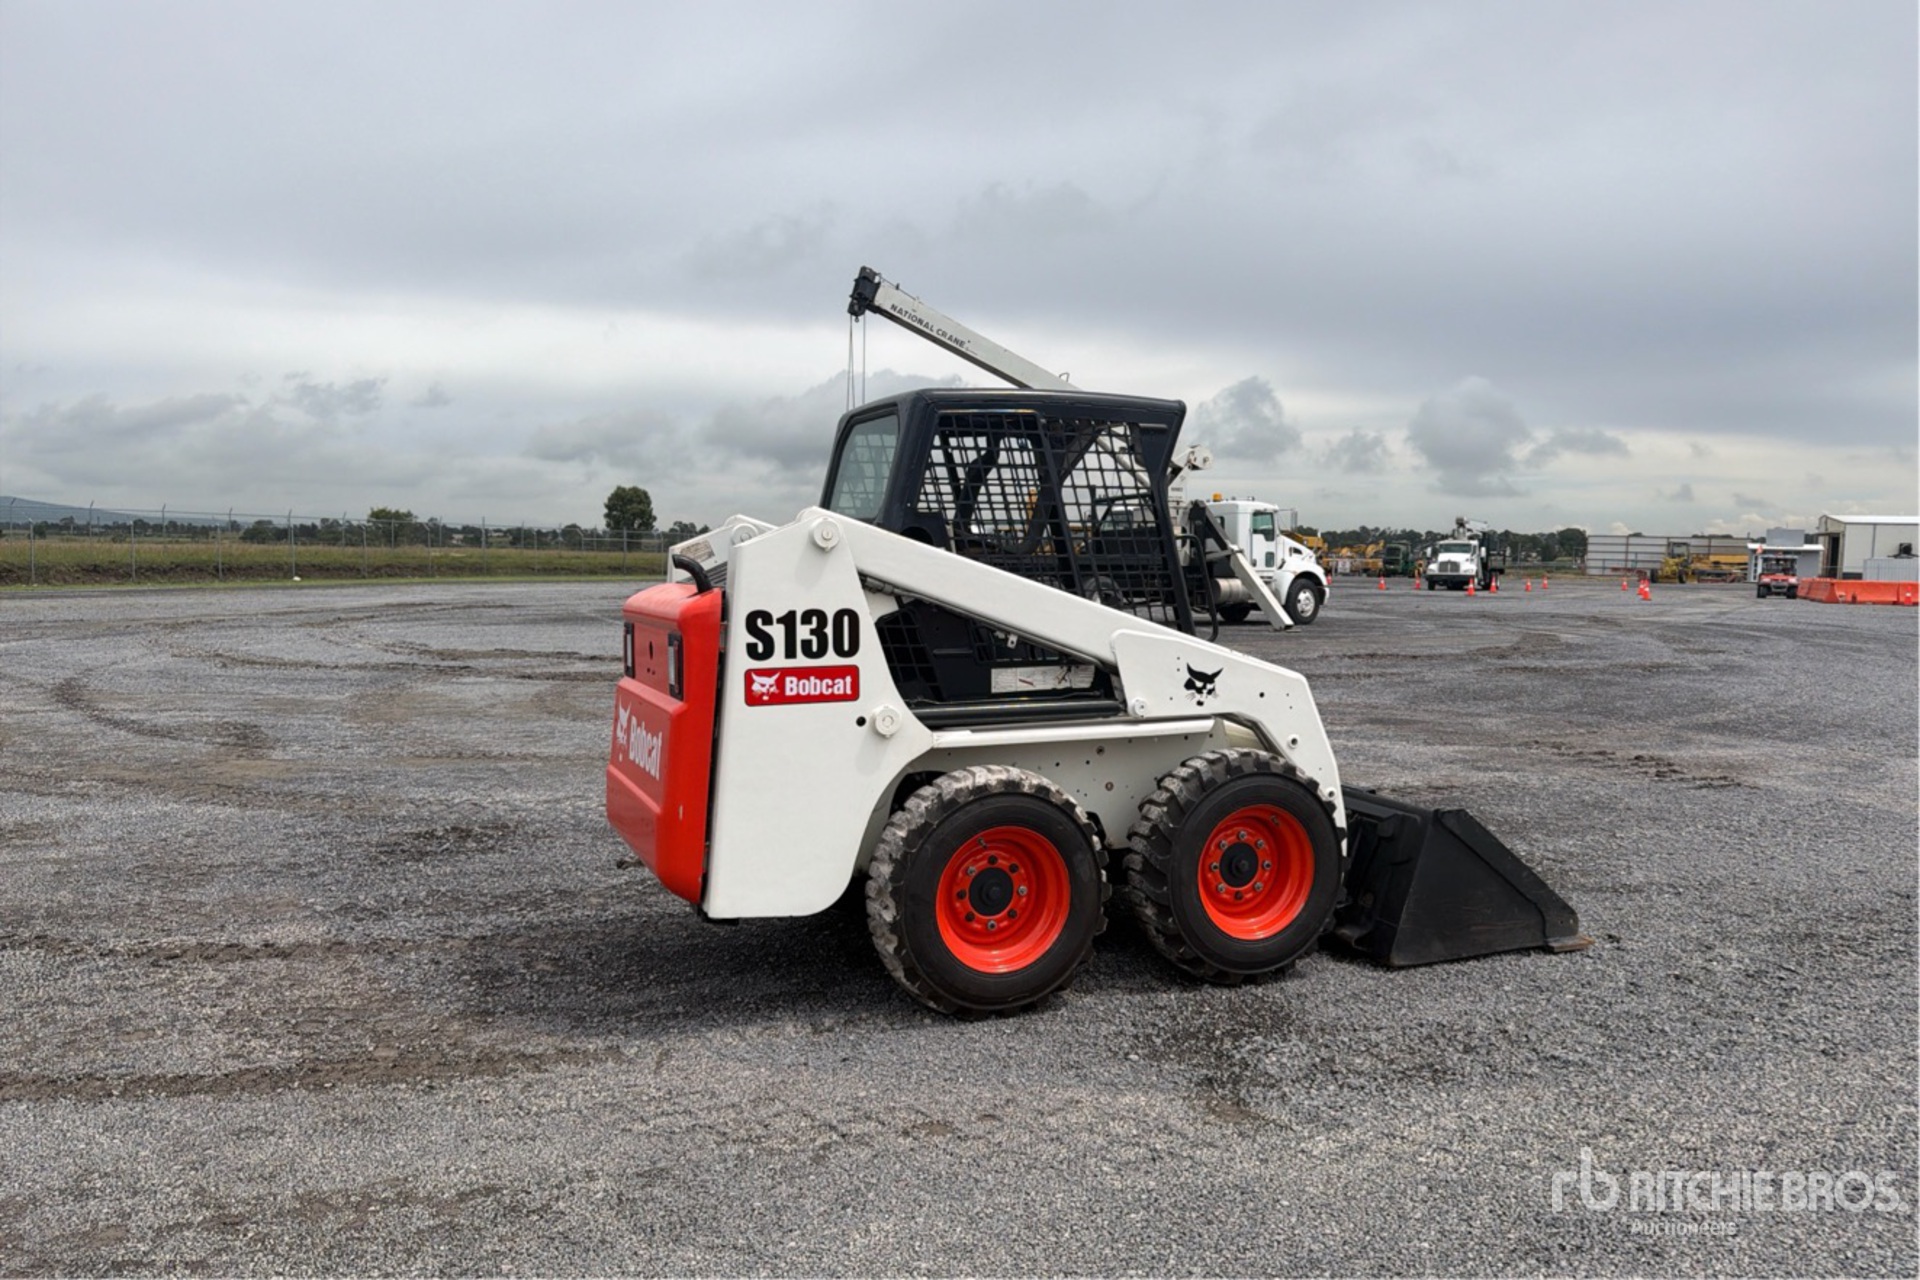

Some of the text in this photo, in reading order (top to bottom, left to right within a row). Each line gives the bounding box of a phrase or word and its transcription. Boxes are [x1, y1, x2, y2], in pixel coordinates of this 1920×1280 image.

[890, 303, 966, 349] NATIONAL CRANE
[745, 608, 860, 661] S130
[785, 675, 852, 696] Bobcat
[629, 715, 663, 781] Bobcat
